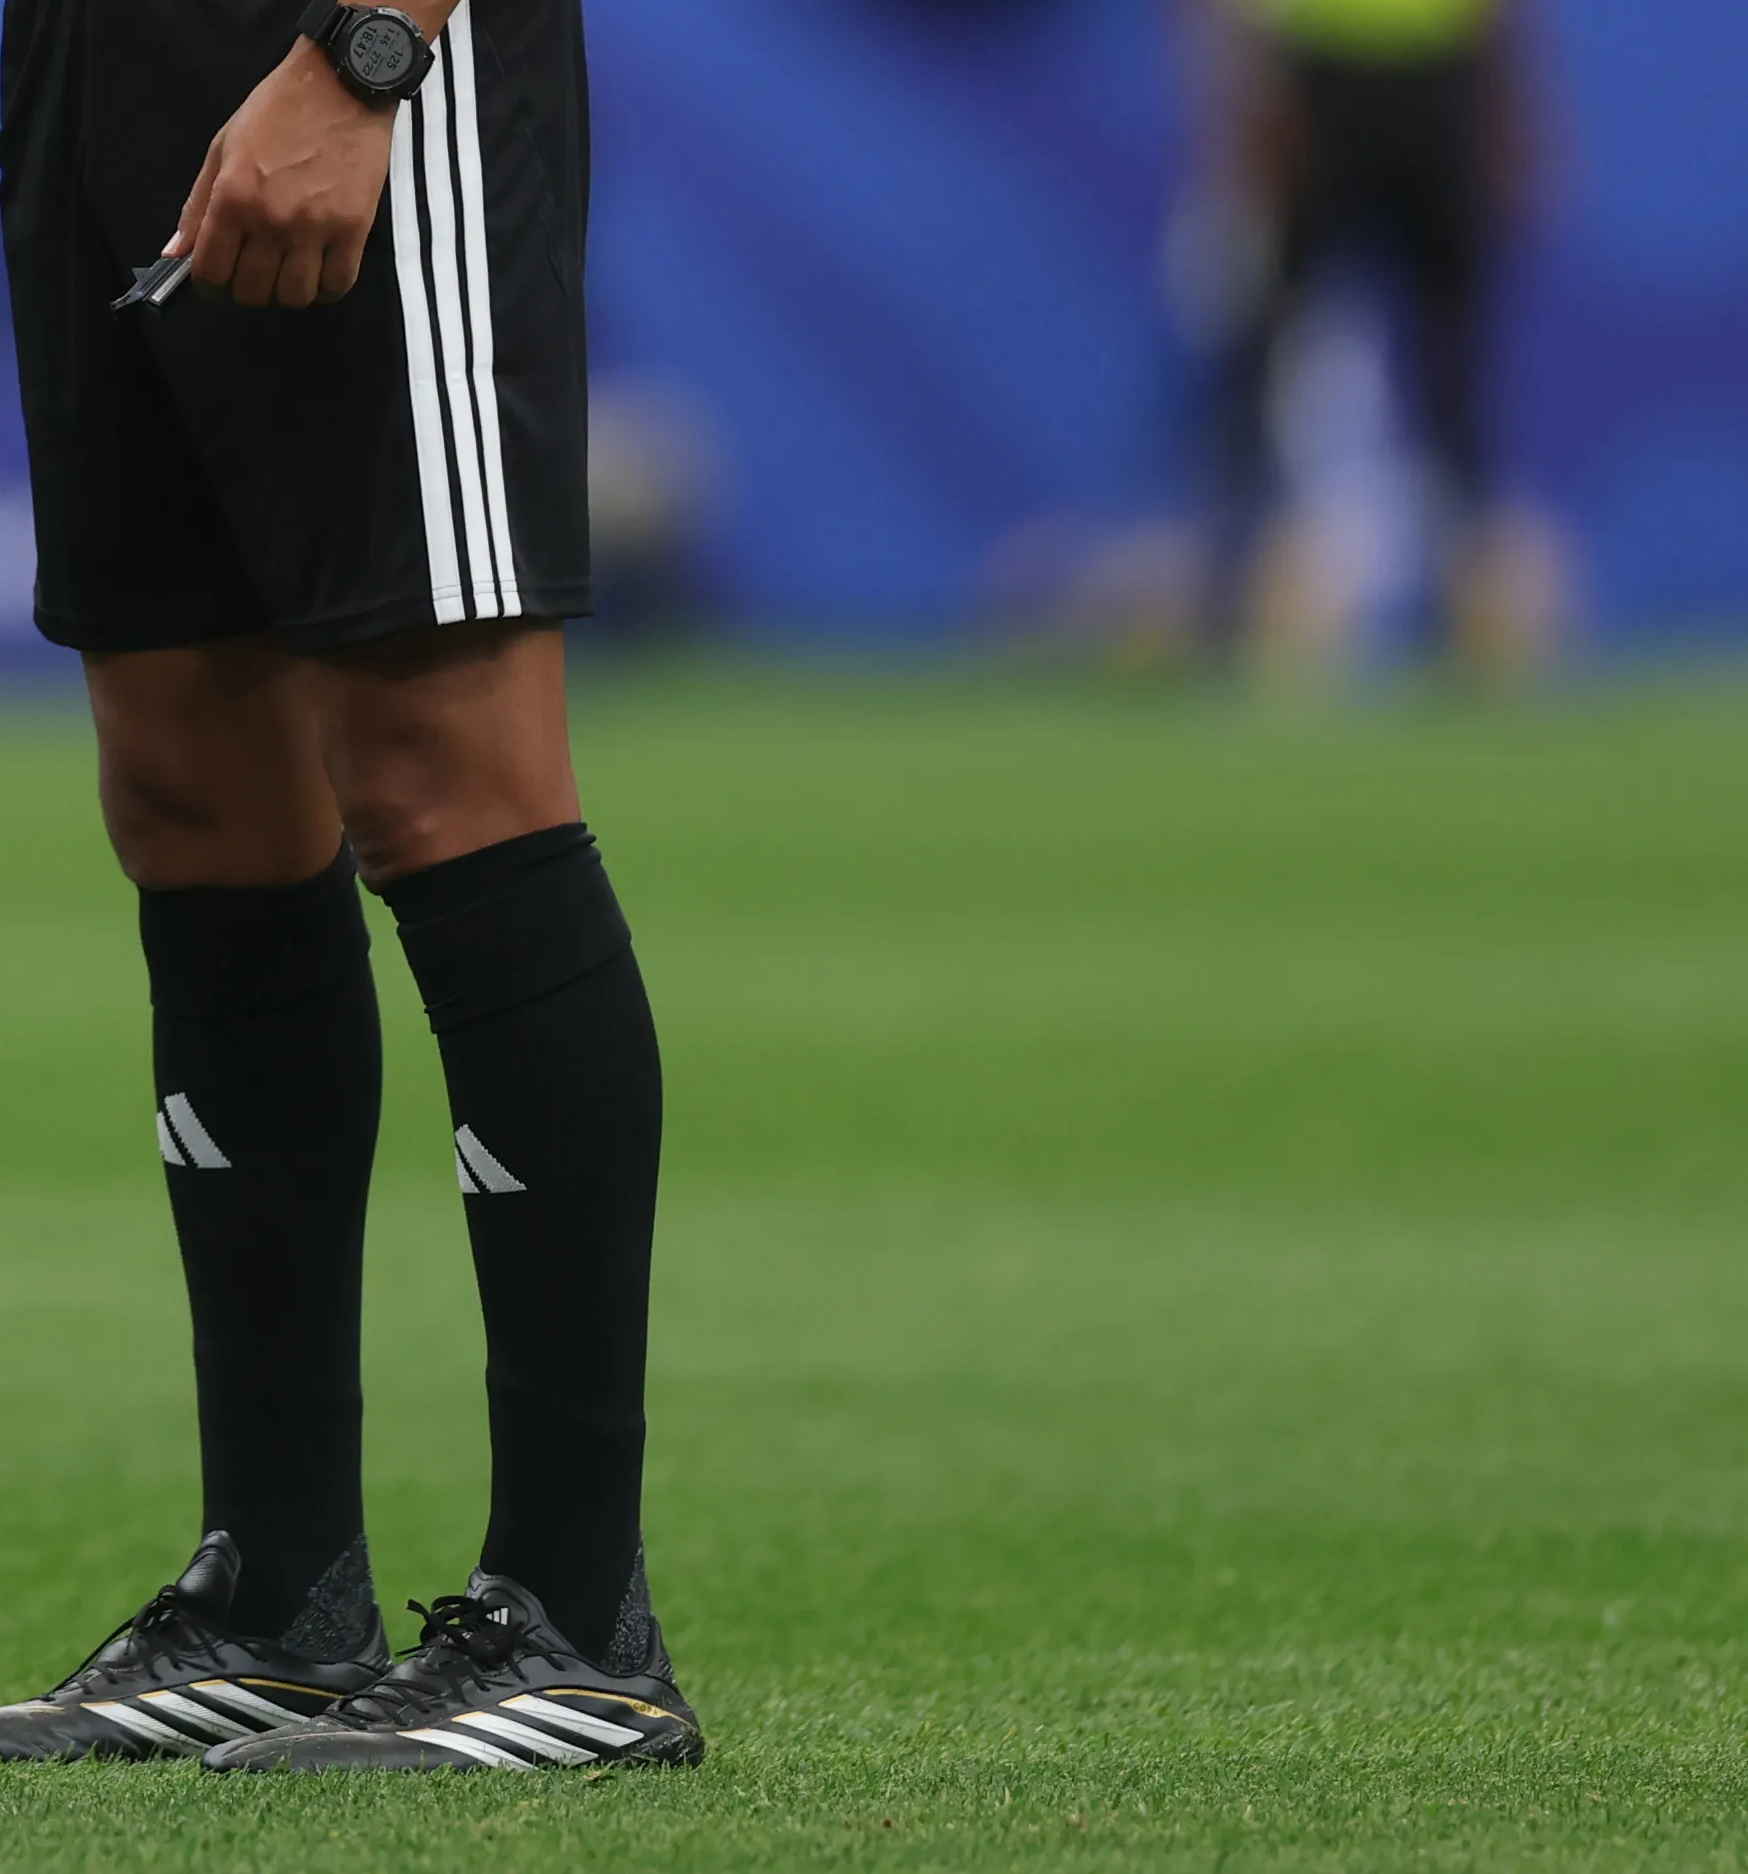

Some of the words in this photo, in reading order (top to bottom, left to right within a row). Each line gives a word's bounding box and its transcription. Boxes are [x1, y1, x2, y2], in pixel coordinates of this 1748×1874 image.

[353, 26, 378, 59] 18:47
[387, 50, 404, 70] 125
[633, 1702, 658, 1715] COPA
